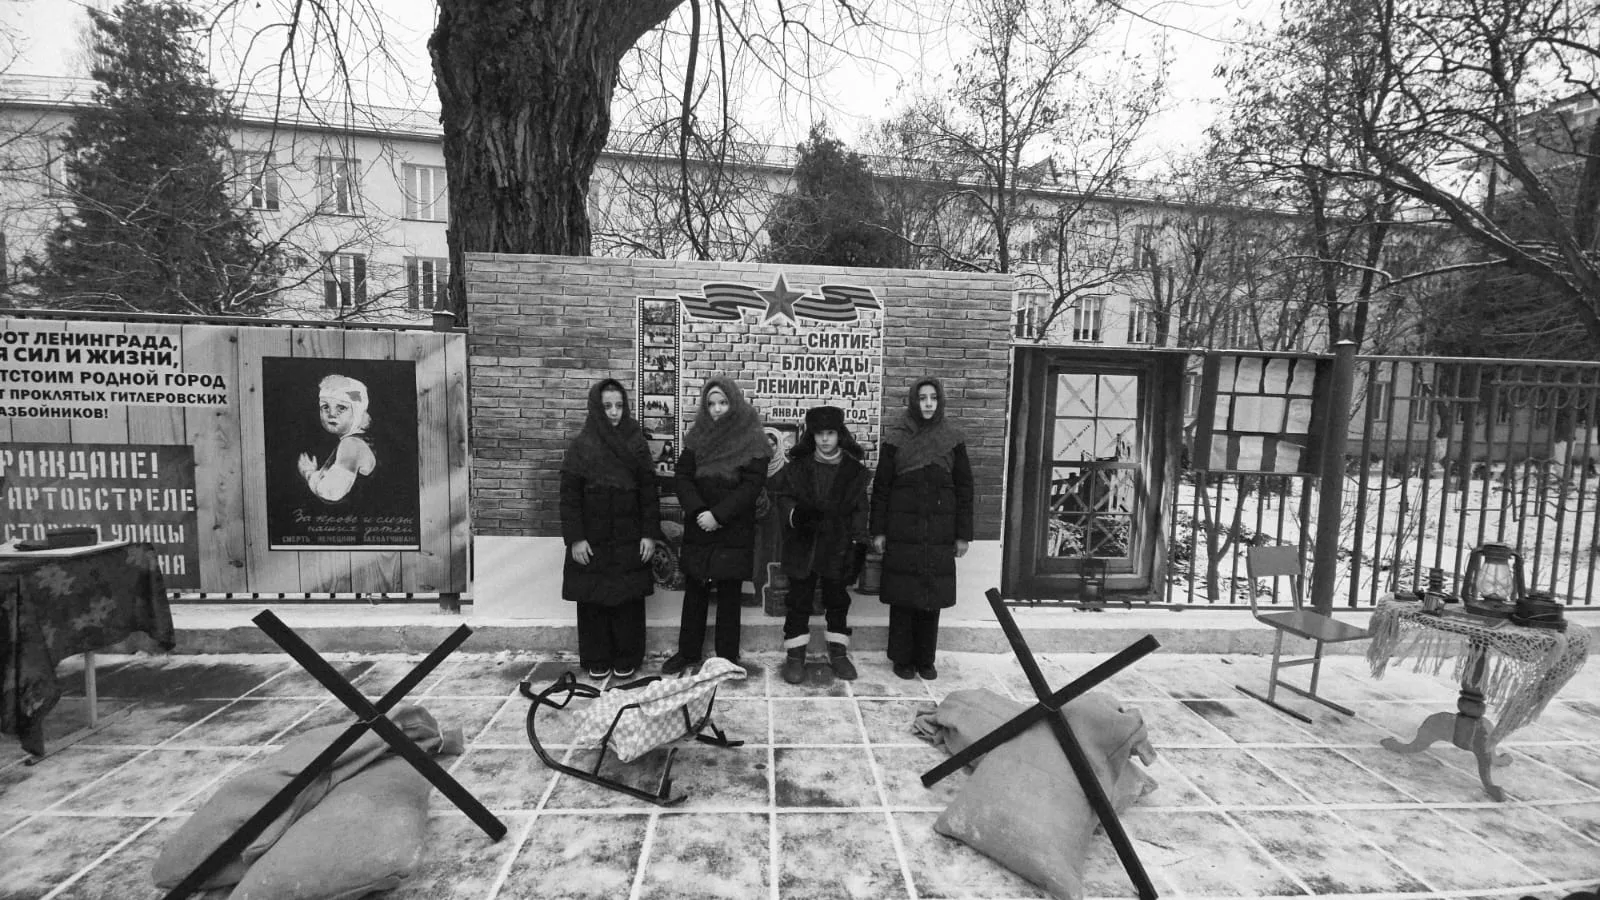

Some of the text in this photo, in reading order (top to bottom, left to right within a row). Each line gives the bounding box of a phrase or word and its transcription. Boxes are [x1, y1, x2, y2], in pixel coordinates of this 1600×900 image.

[33, 332, 178, 351] ЛЕНИНГРАДА,
[807, 332, 870, 349] СНЯТИЕ
[14, 347, 60, 363] СИЛ
[67, 349, 81, 363] И
[87, 349, 179, 368] ЖИЗНИ,
[782, 355, 869, 375] БЛОКАДЫ
[80, 370, 159, 386] РОДНОЙ
[165, 374, 226, 390] ГОРОД
[756, 378, 868, 398] ЛЕНИНГРАДА
[10, 389, 106, 402] ПРОКЛЯТЫХ
[111, 391, 227, 404] ГИТЛЕРОВСКИХ
[772, 407, 868, 420] ЯНВАР ГОД
[8, 487, 195, 511] АРТОБСТРЕЛЕ
[111, 524, 185, 544] УЛИЦЫ
